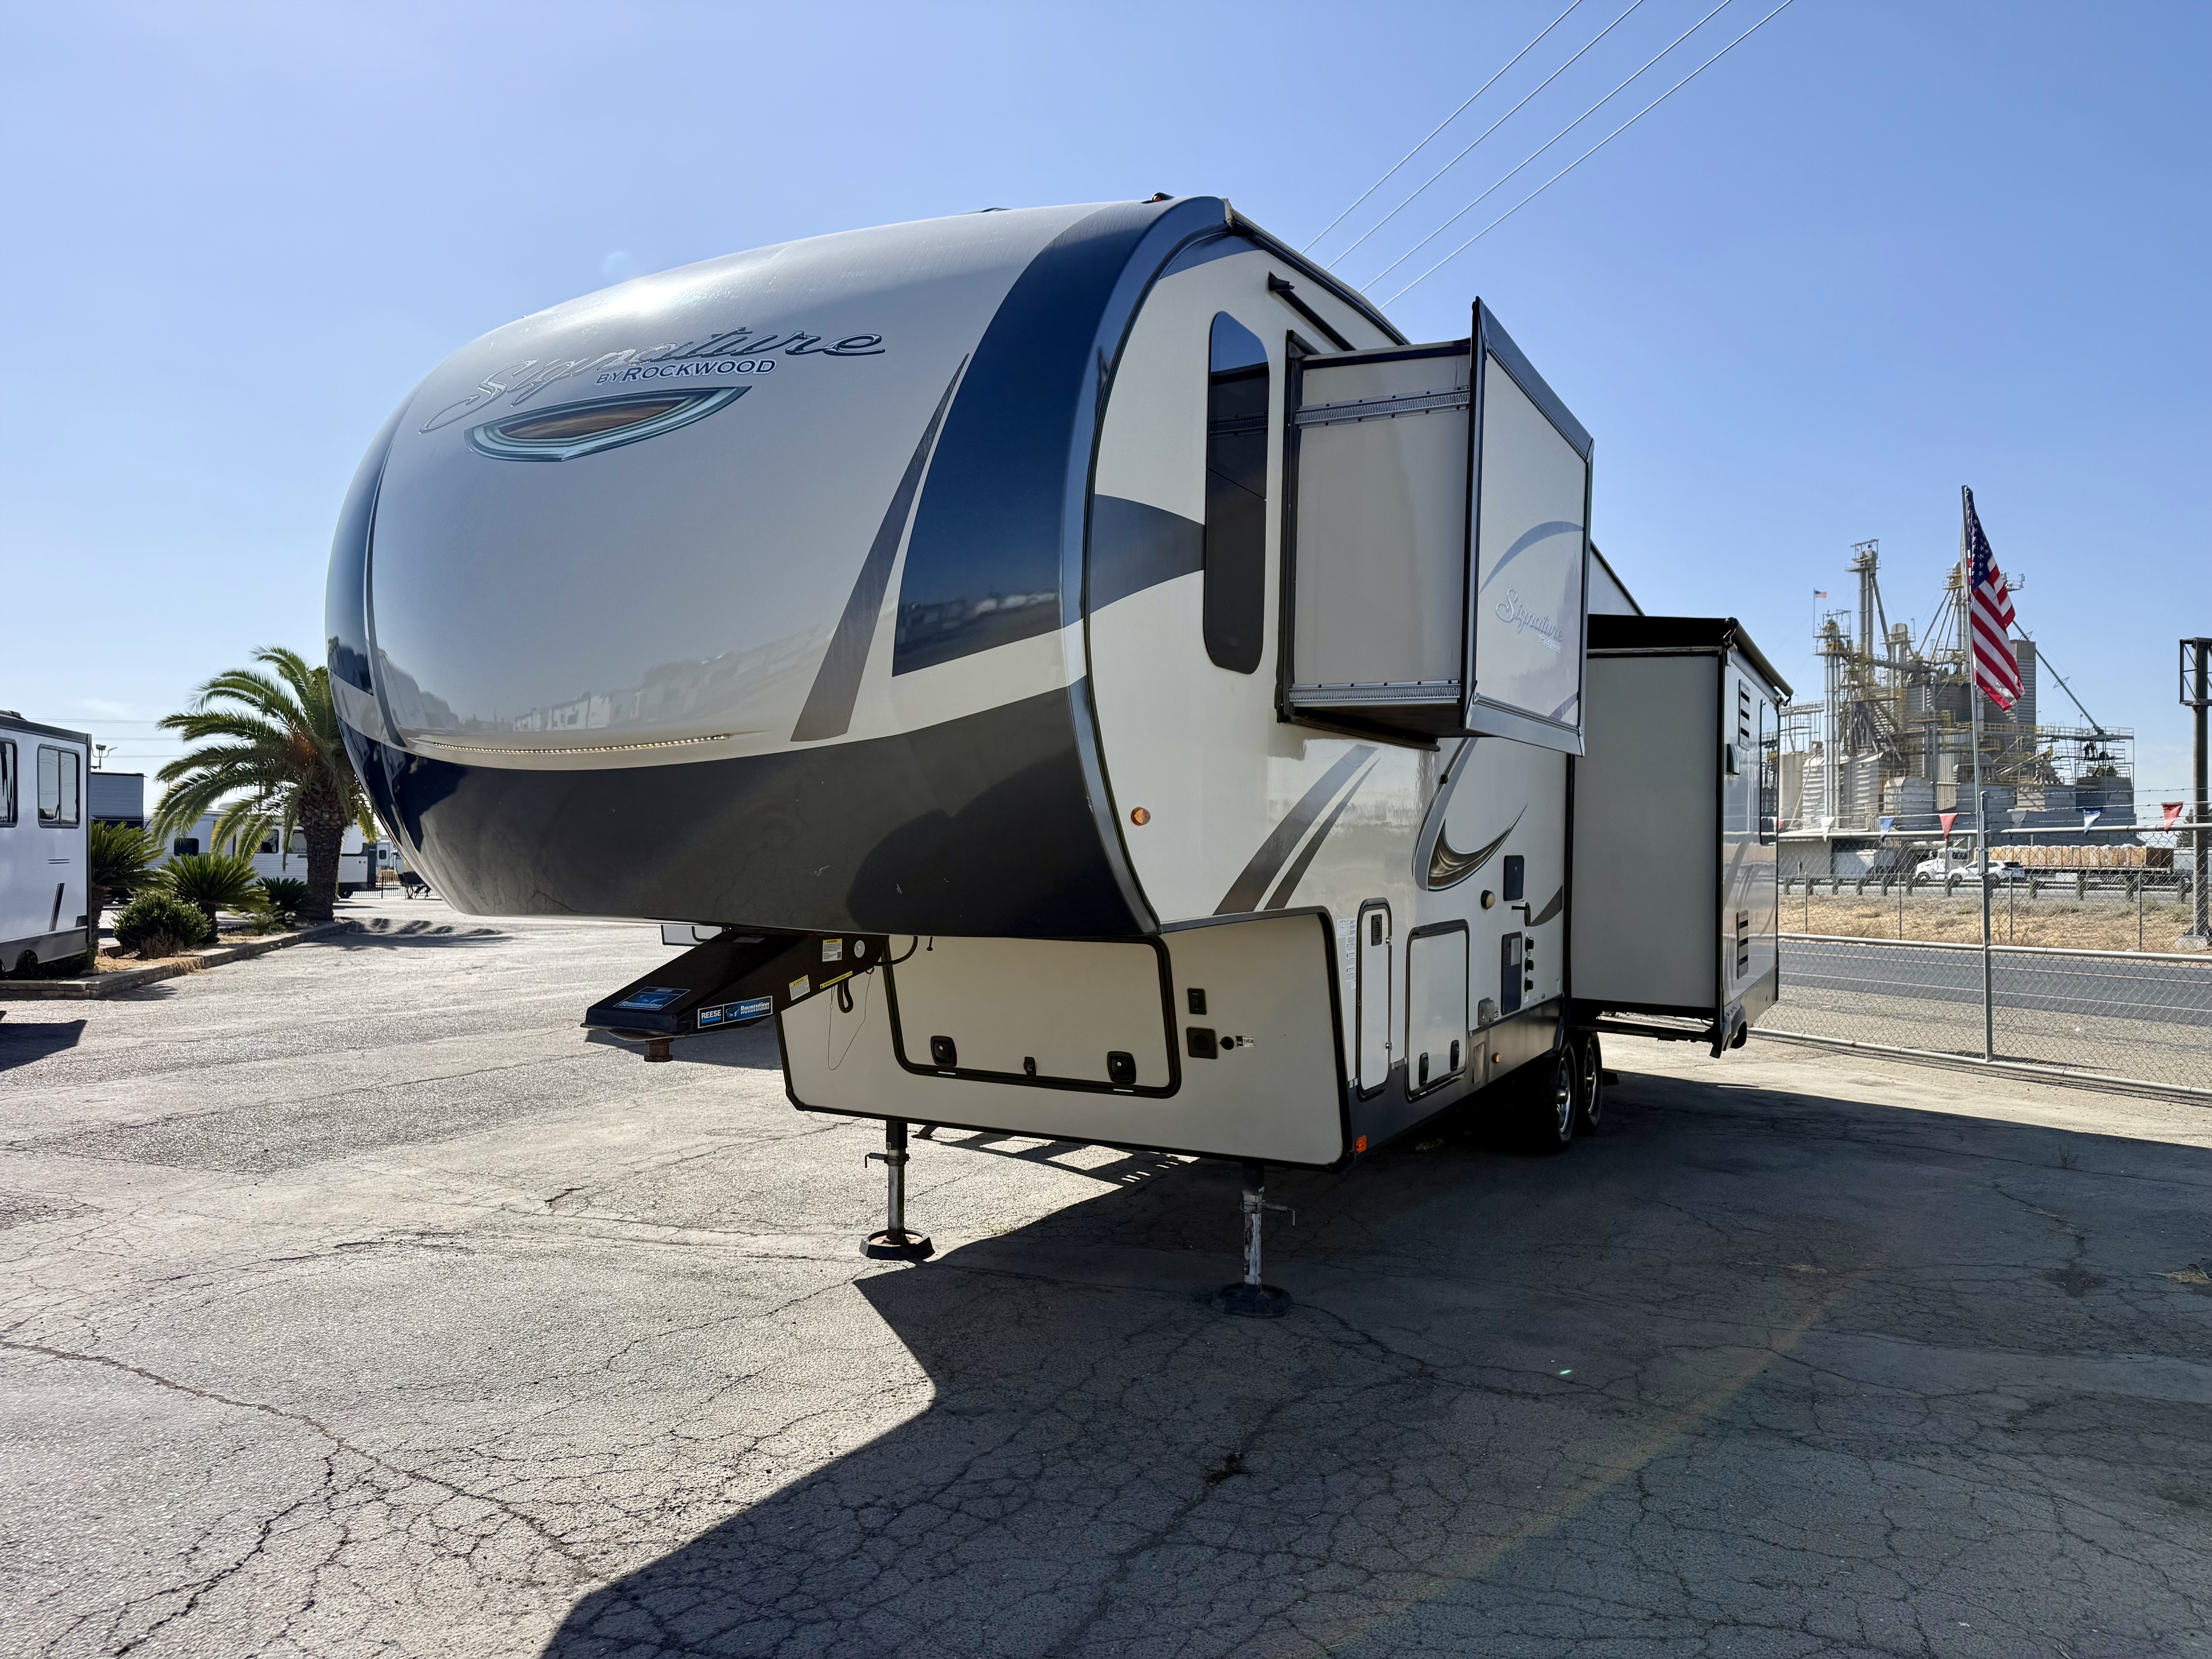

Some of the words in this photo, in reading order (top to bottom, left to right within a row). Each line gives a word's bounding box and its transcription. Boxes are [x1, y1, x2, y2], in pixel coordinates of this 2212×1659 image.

[419, 326, 885, 434] Signature
[597, 372, 623, 383] BY
[621, 360, 776, 382] ROCKWOOD
[1496, 588, 1564, 642] Signature
[701, 1010, 721, 1019] REESE
[740, 1002, 769, 1014] Revolution
